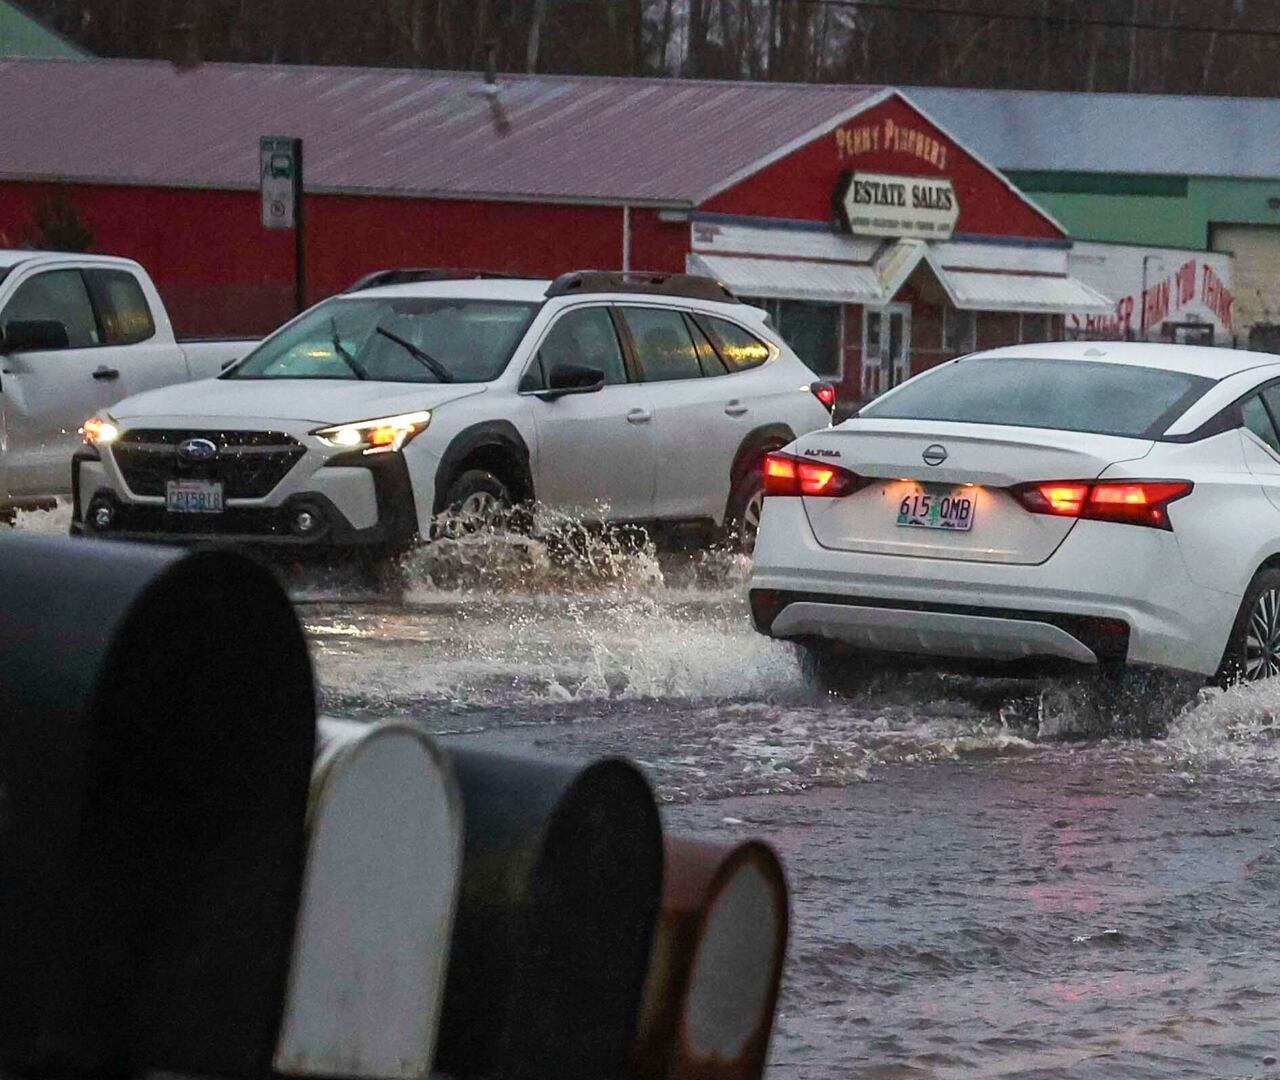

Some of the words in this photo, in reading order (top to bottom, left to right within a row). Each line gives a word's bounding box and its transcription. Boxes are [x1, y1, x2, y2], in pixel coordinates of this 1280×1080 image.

[853, 180, 906, 207] ESTATE
[912, 184, 952, 211] SALES
[804, 448, 841, 458] ALTIMA
[900, 495, 929, 518] 615
[940, 495, 972, 521] QMB
